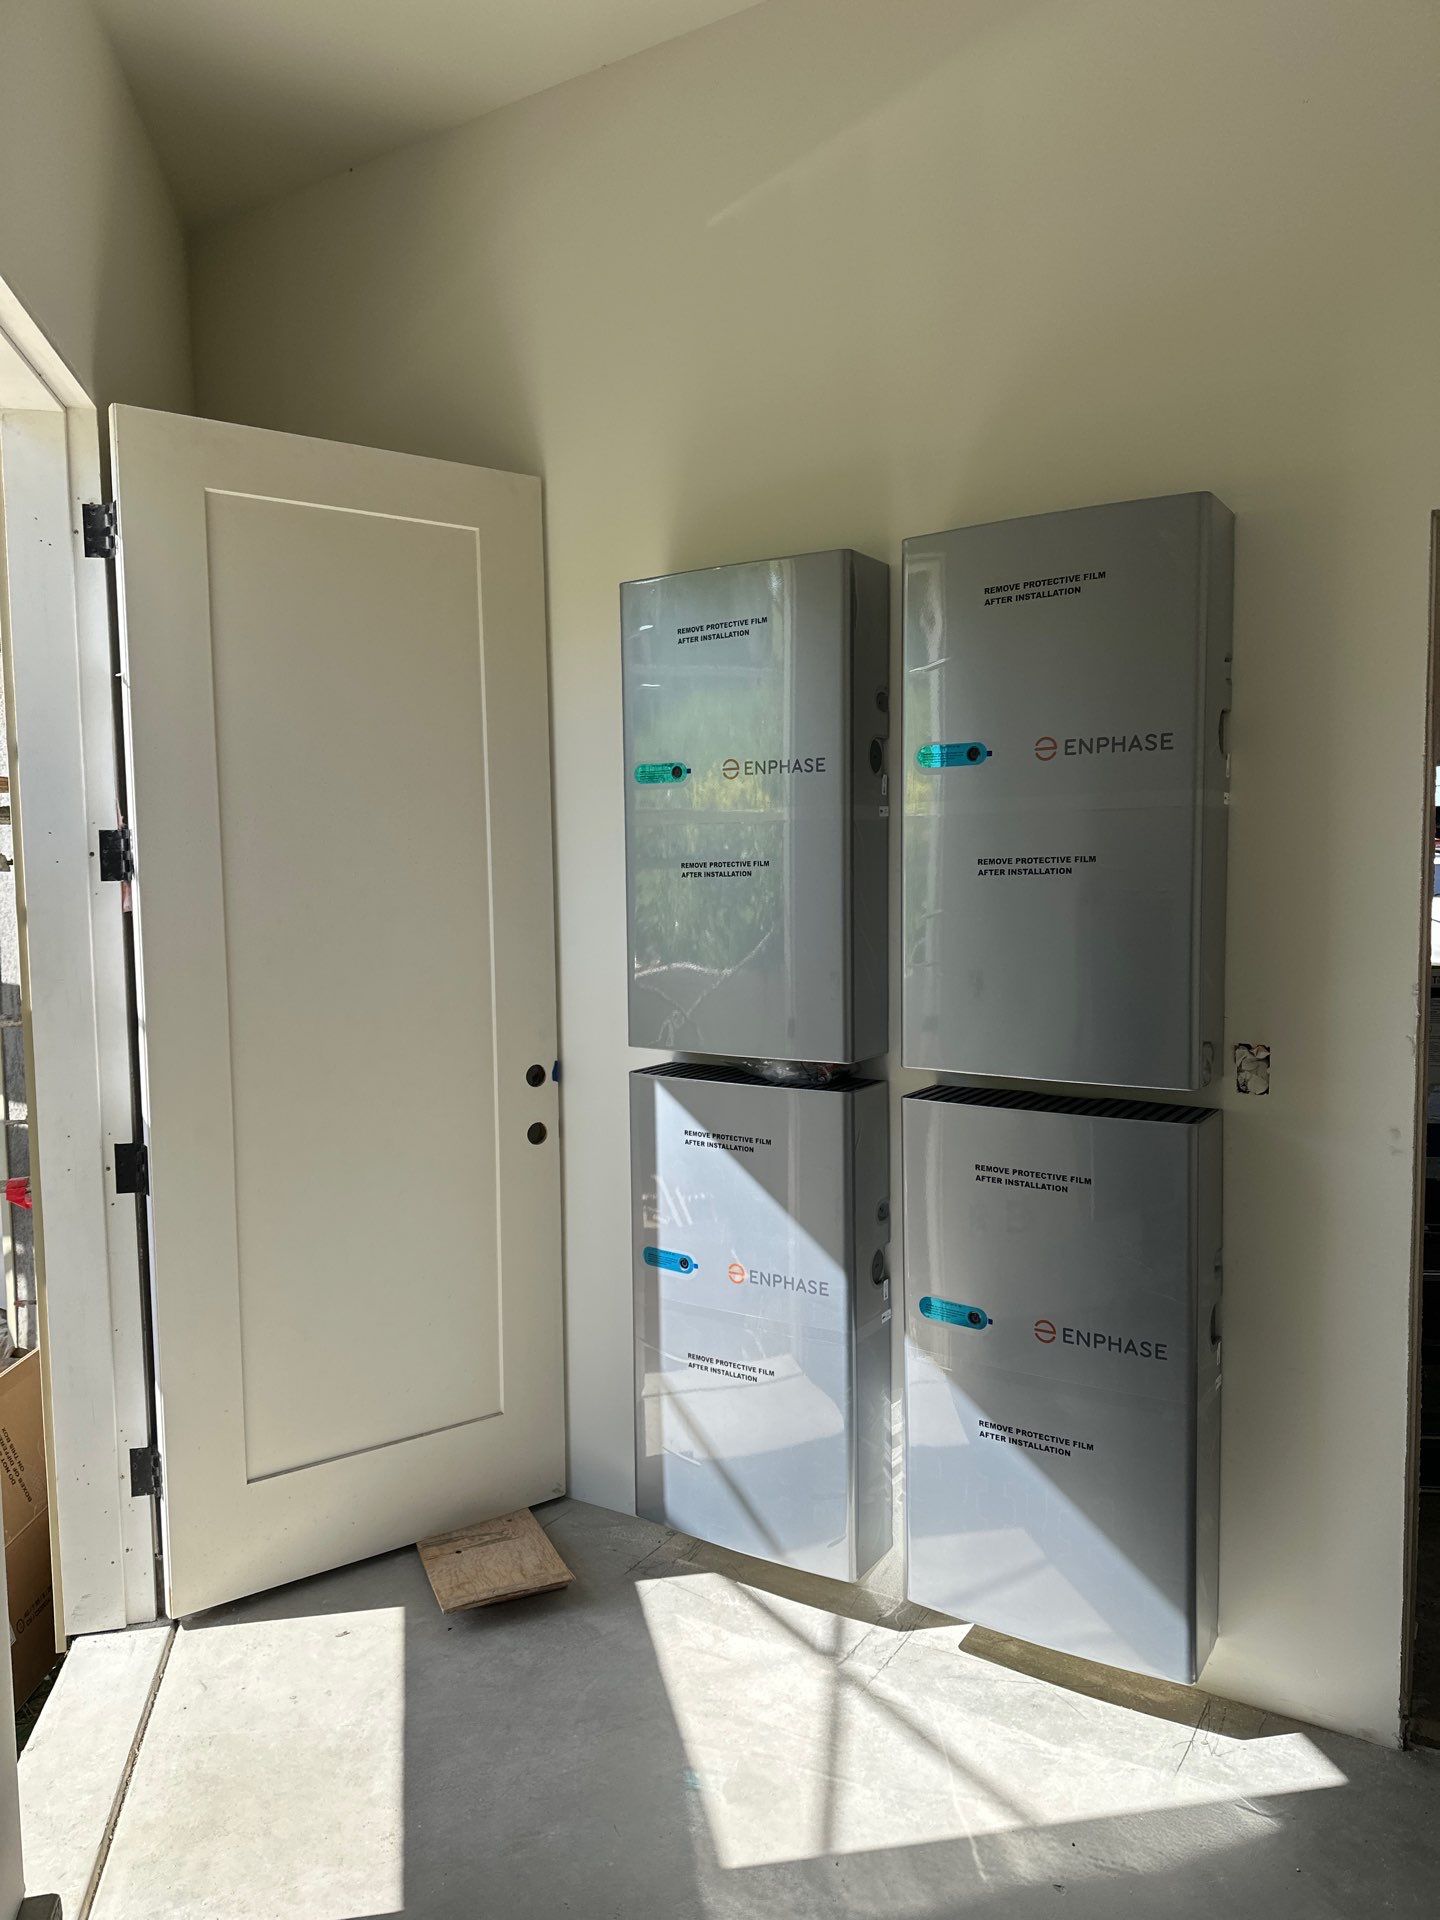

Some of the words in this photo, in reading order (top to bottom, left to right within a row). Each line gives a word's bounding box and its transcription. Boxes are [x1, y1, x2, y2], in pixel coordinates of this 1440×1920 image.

[984, 583, 1020, 594] REMOVE
[1023, 575, 1080, 590] PROTECTIVE
[1084, 572, 1105, 580] FILM
[985, 596, 1012, 606] AFTER
[1016, 587, 1081, 601] INSTALLATION
[677, 626, 704, 634] REMOVE
[706, 619, 748, 630] PROTECTIVE
[678, 636, 698, 644] AFTER
[701, 630, 749, 641] INSTALLATION
[1065, 732, 1173, 755] ENPHASE
[745, 758, 825, 775] ENPHASE
[1016, 856, 1071, 864] PROTECTIVE
[685, 1130, 710, 1138] REMOVE
[712, 1133, 753, 1143] PROTECTIVE
[685, 1139, 705, 1147] AFTER
[707, 1142, 754, 1152] INSTALLATION
[975, 1164, 1009, 1174] REMOVE
[1013, 1169, 1067, 1182] PROTECTIVE
[1070, 1176, 1091, 1184] FILM
[976, 1175, 1002, 1184] AFTER
[1005, 1179, 1068, 1192] INSTALLATION
[750, 1270, 829, 1296] ENPHASE
[1063, 1328, 1167, 1360] ENPHASE
[688, 1353, 713, 1364] REMOVE
[716, 1359, 756, 1373] PROTECTIVE
[759, 1368, 774, 1376] FILM
[689, 1363, 708, 1372] AFTER
[710, 1367, 757, 1382] INSTALLATION
[979, 1420, 1013, 1433] REMOVE
[1016, 1428, 1070, 1446] PROTECTIVE
[1073, 1441, 1093, 1451] FILM
[979, 1431, 1006, 1442] AFTER
[1009, 1437, 1070, 1456] INSTALLATION
